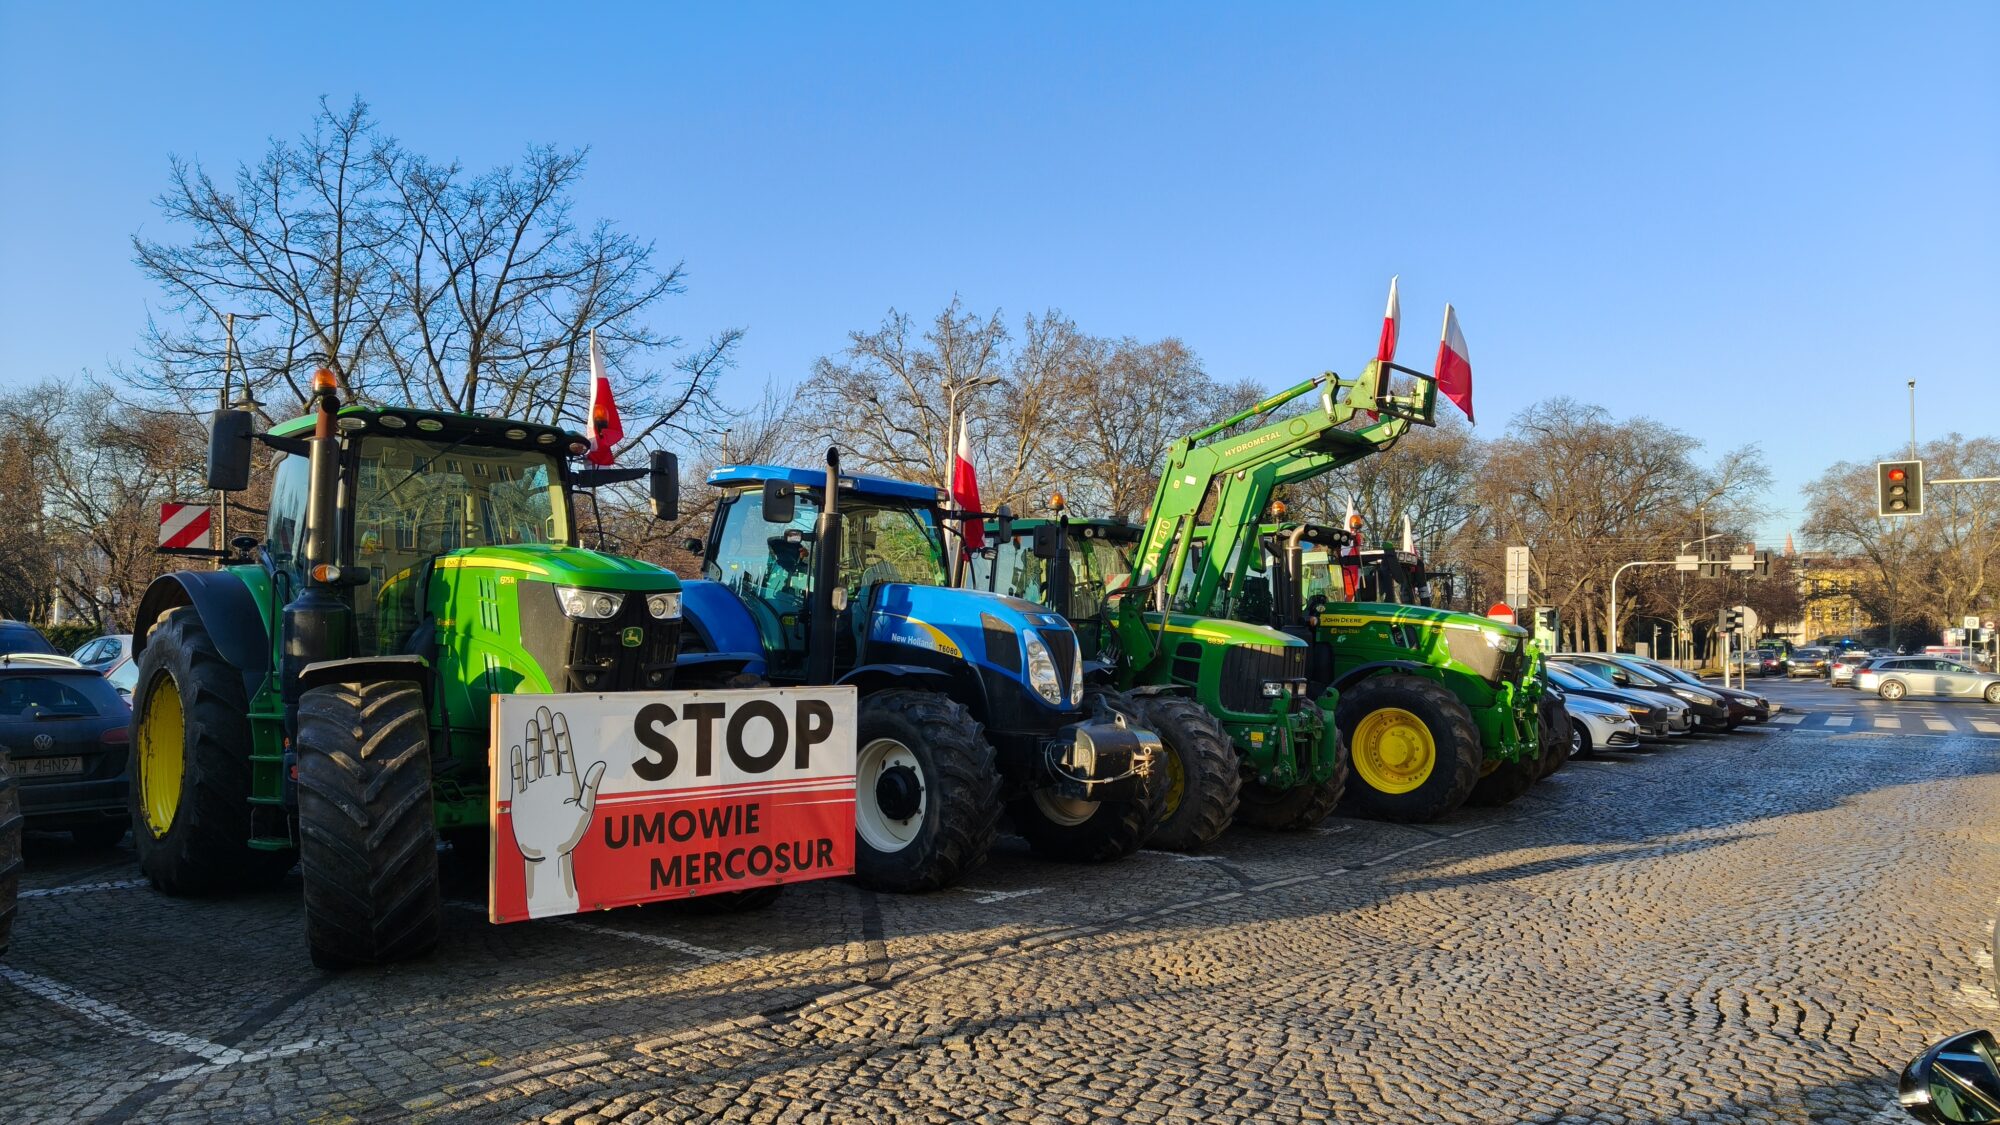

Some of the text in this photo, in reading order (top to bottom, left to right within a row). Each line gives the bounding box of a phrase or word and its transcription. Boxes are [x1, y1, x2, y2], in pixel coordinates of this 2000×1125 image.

[1224, 431, 1281, 457] HYDROMETAL
[1160, 520, 1172, 540] 40
[891, 633, 933, 648] New Holland
[938, 644, 958, 656] T6080
[631, 699, 834, 782] STOP
[33, 758, 78, 773] 4HN97
[604, 802, 760, 849] UMOWIE
[650, 838, 834, 891] MERCOSUR
